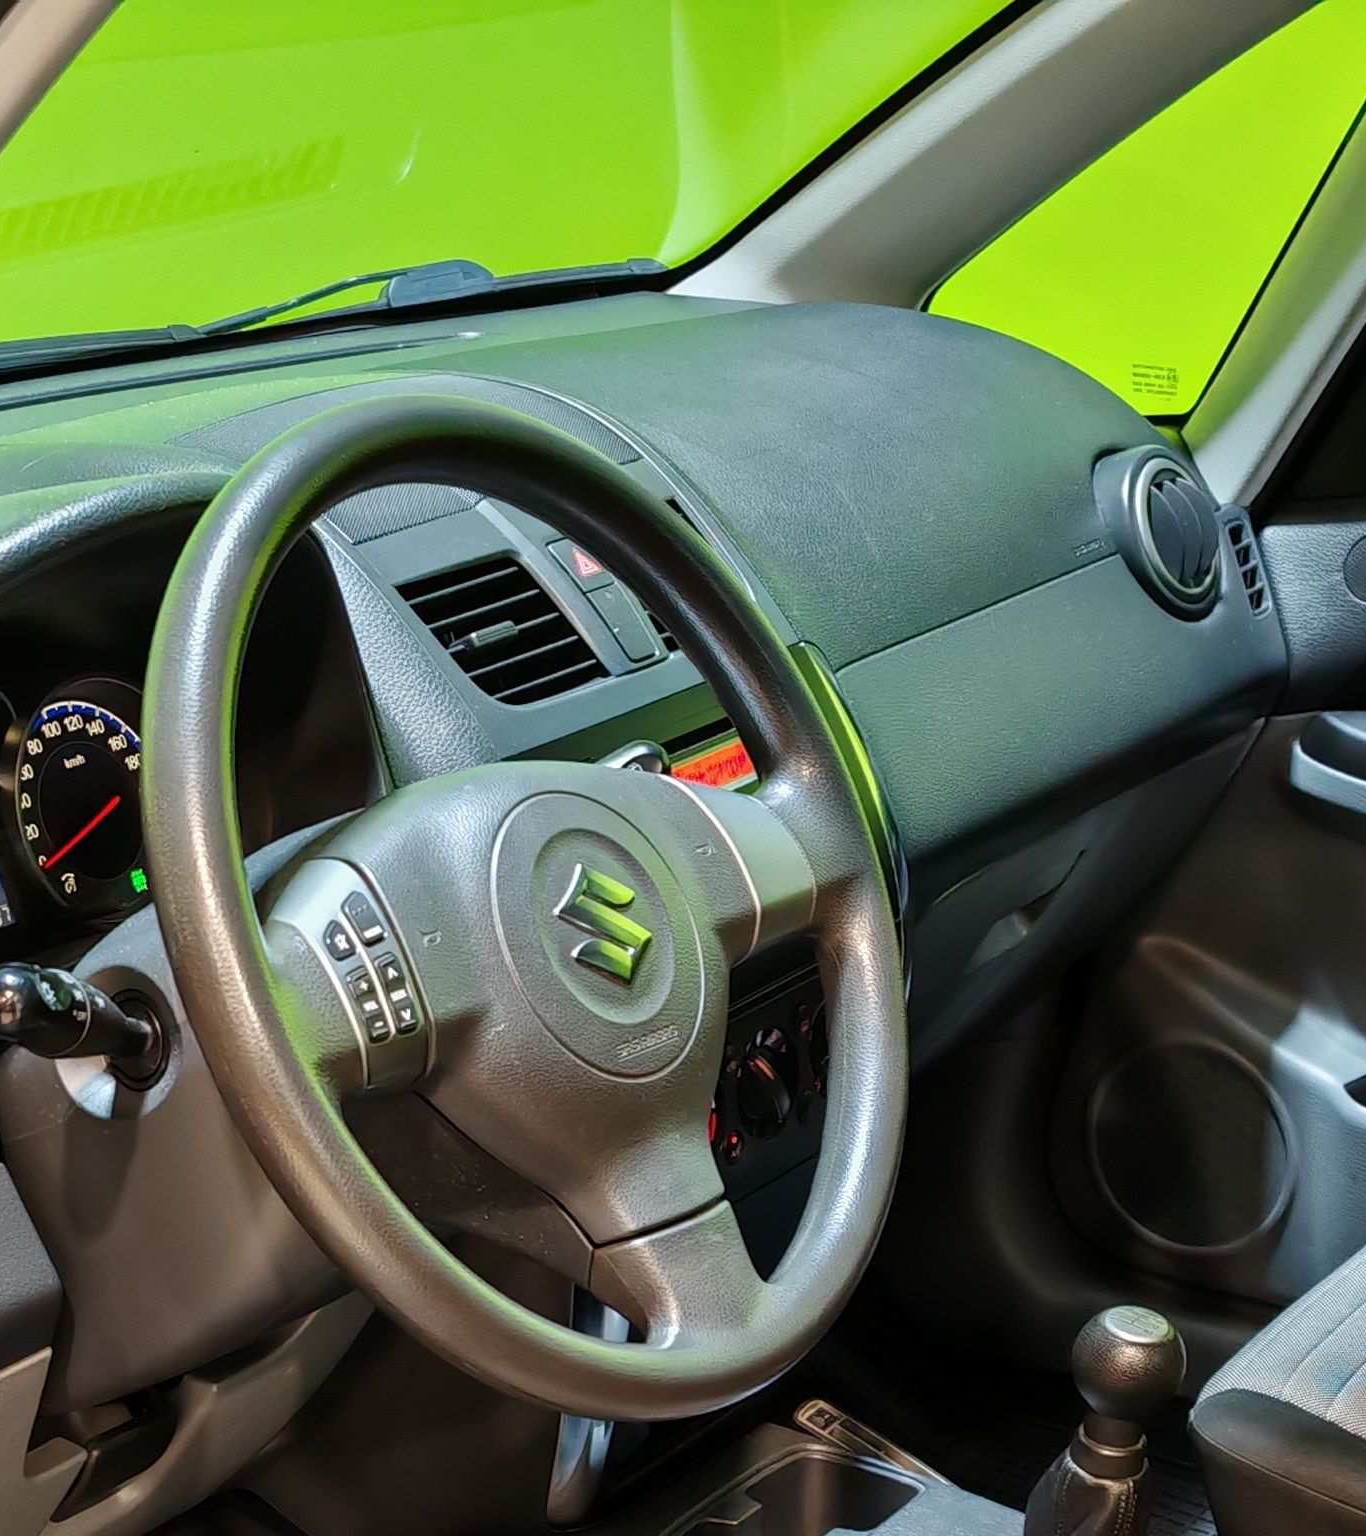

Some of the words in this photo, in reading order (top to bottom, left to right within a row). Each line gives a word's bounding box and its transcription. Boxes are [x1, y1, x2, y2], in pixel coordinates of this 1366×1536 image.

[41, 721, 62, 739] 100
[63, 714, 84, 732] 120
[85, 719, 105, 737] 140
[26, 738, 44, 755] 80
[108, 734, 128, 752] 160
